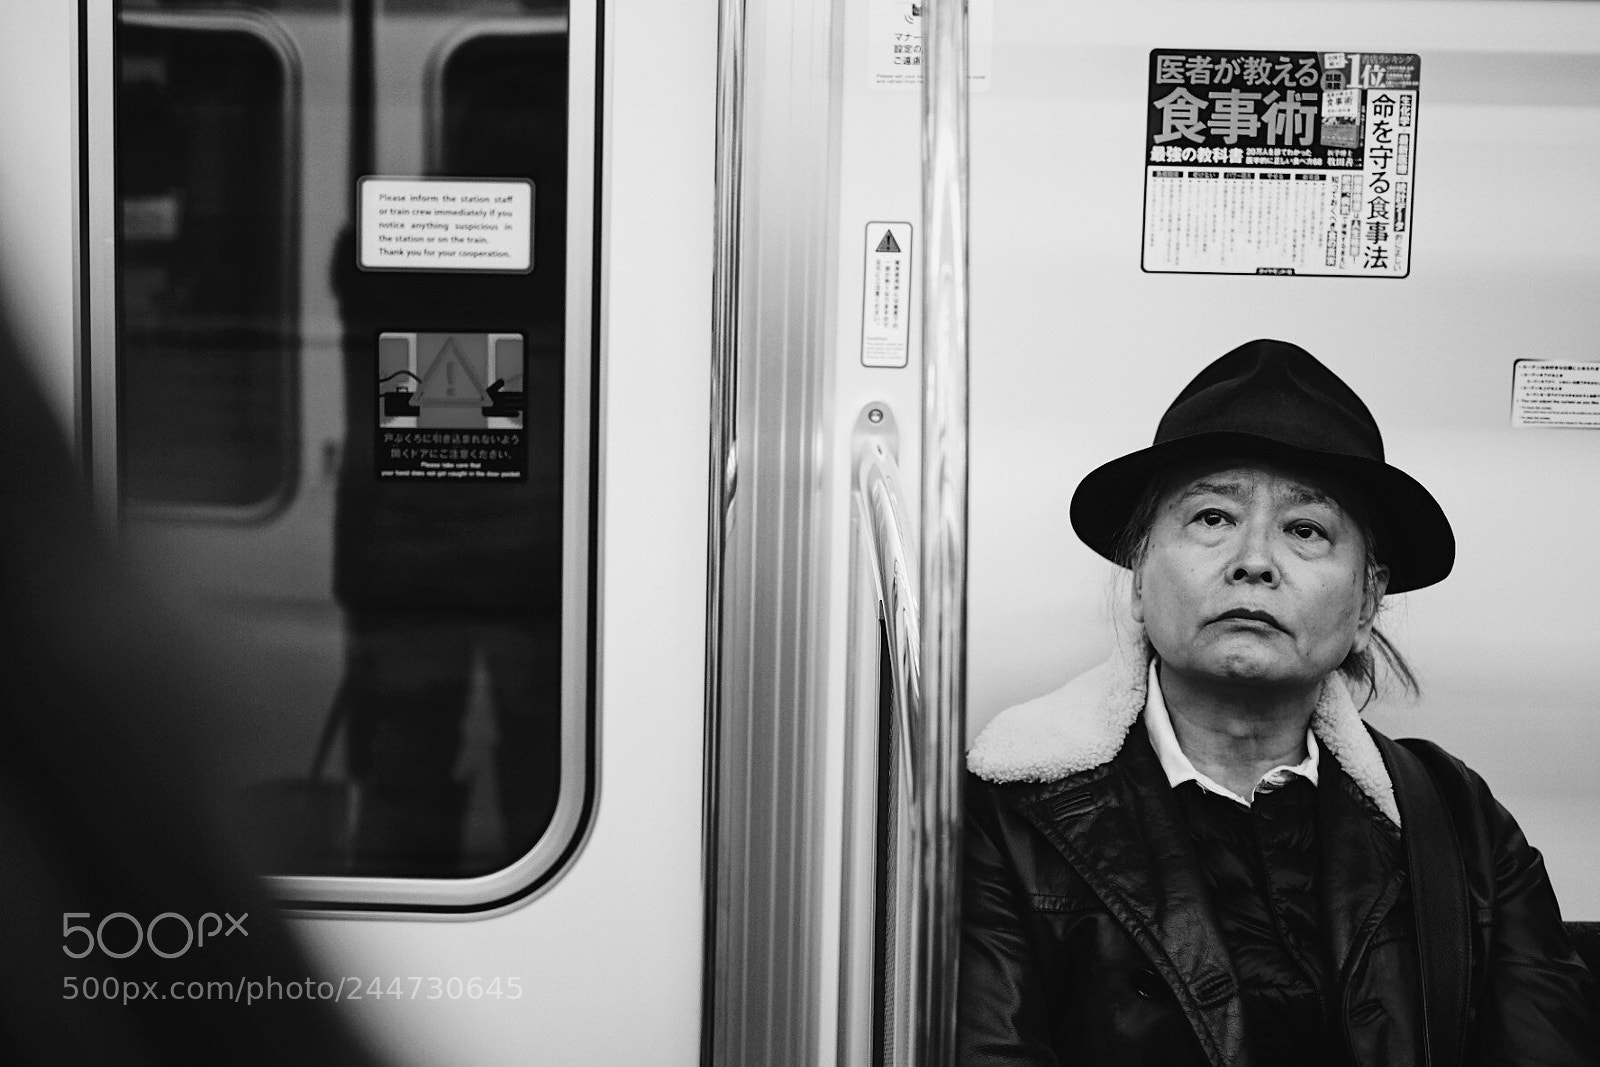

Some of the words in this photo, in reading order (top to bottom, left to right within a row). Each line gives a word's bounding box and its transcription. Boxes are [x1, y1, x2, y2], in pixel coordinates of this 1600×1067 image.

[1155, 54, 1319, 87] 医者が教える
[1152, 85, 1319, 147] 食事術
[1149, 145, 1245, 165] 最強の教科書
[1363, 93, 1398, 269] 命を守る食事法
[379, 193, 405, 201] Please
[460, 195, 490, 203] station
[494, 195, 513, 203] staff
[434, 208, 487, 218] immediately
[411, 222, 448, 231] anything
[455, 223, 498, 231] suspicious
[379, 247, 404, 256] Thank
[420, 461, 440, 469] Please
